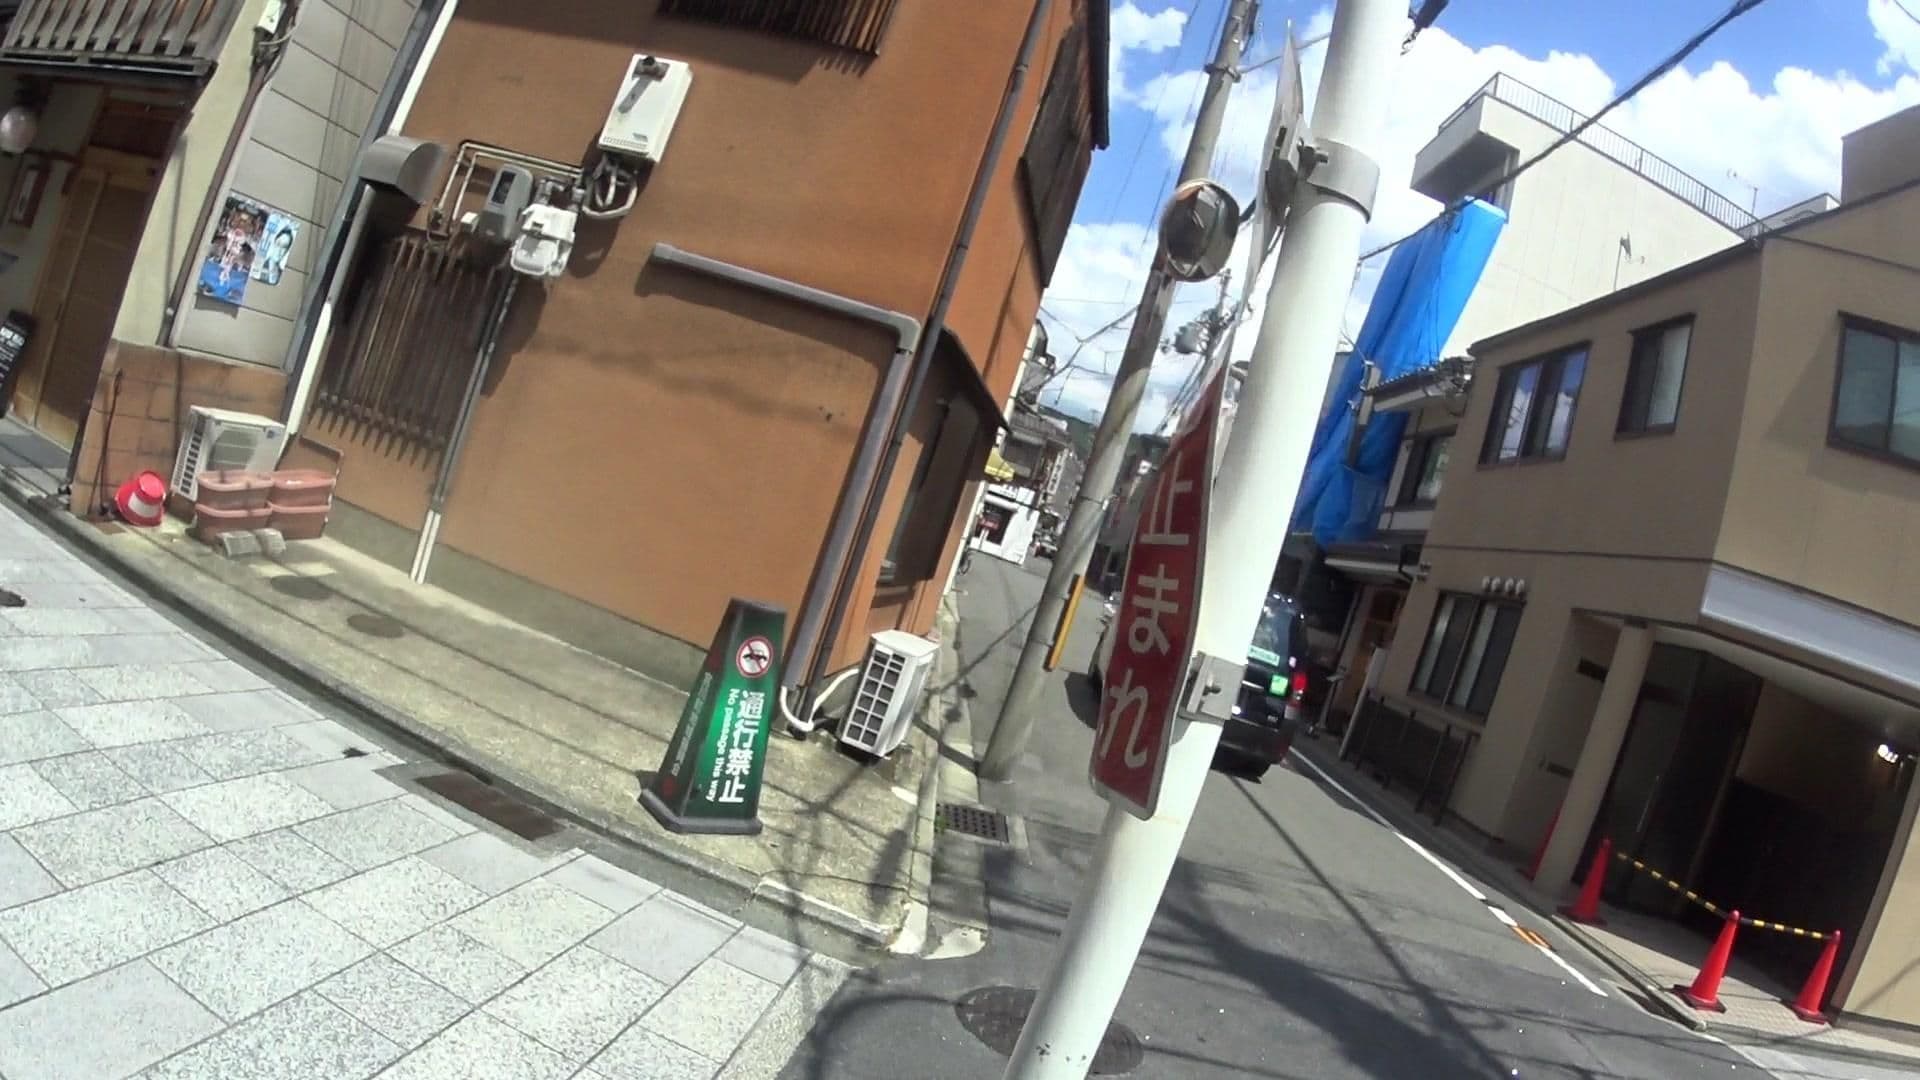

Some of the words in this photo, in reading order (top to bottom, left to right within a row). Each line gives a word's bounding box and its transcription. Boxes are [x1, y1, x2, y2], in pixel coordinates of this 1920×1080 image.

[1101, 451, 1192, 768] 止まれ
[727, 688, 740, 705] No
[717, 707, 733, 755] passage
[718, 690, 765, 802] 通行禁止
[712, 757, 725, 778] this
[705, 780, 719, 802] way
